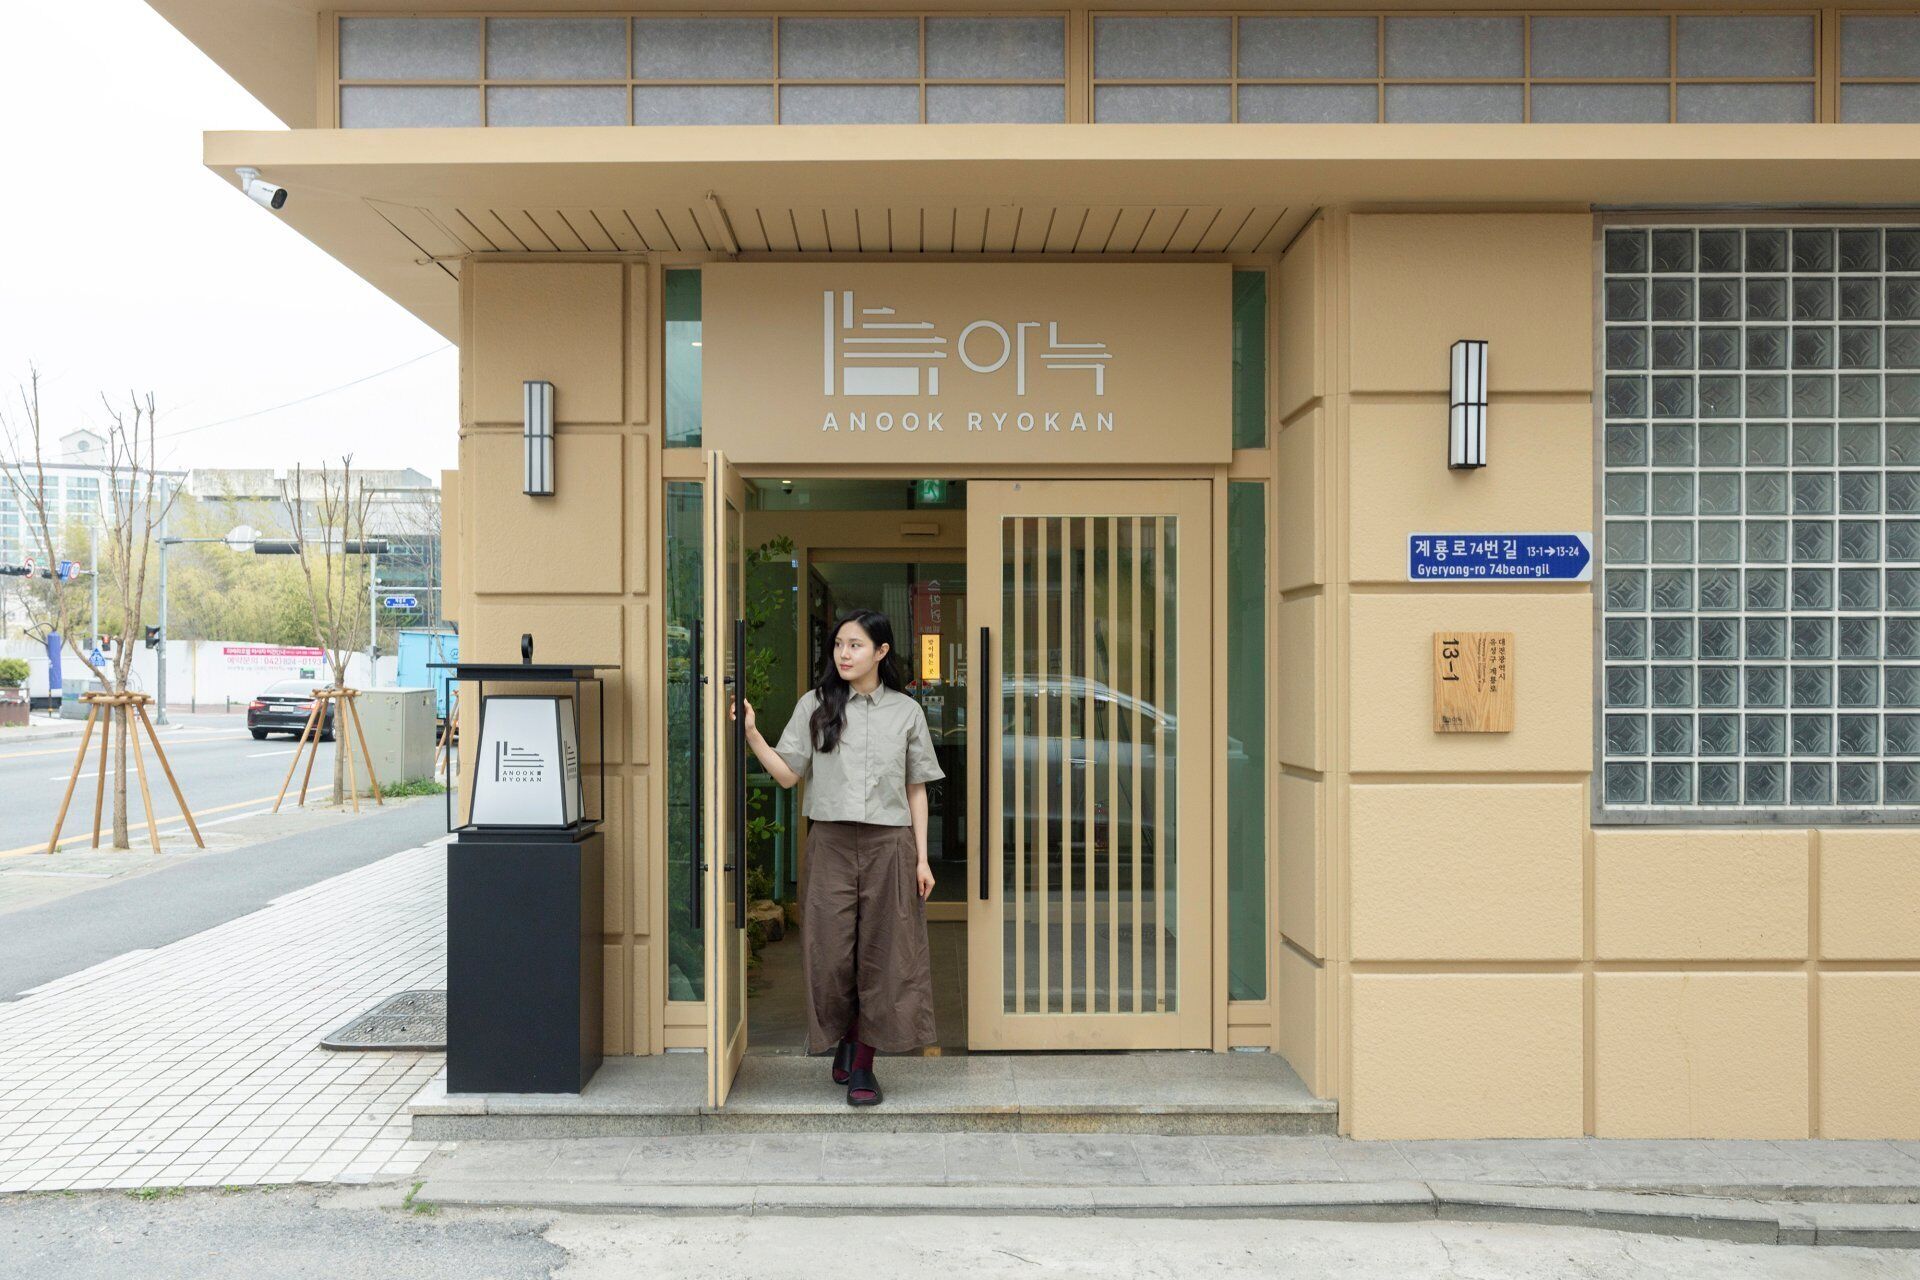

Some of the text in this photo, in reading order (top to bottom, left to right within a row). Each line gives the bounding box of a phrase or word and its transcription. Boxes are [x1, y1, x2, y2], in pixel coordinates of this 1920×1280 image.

[822, 412, 1114, 432] ANOOK RYOKAN
[1415, 540, 1517, 561] 계룡로74번길
[1556, 546, 1580, 557] 13-24
[1417, 563, 1550, 577] Gyeryong-ro 74beon-gil
[1442, 638, 1460, 681] 13-1
